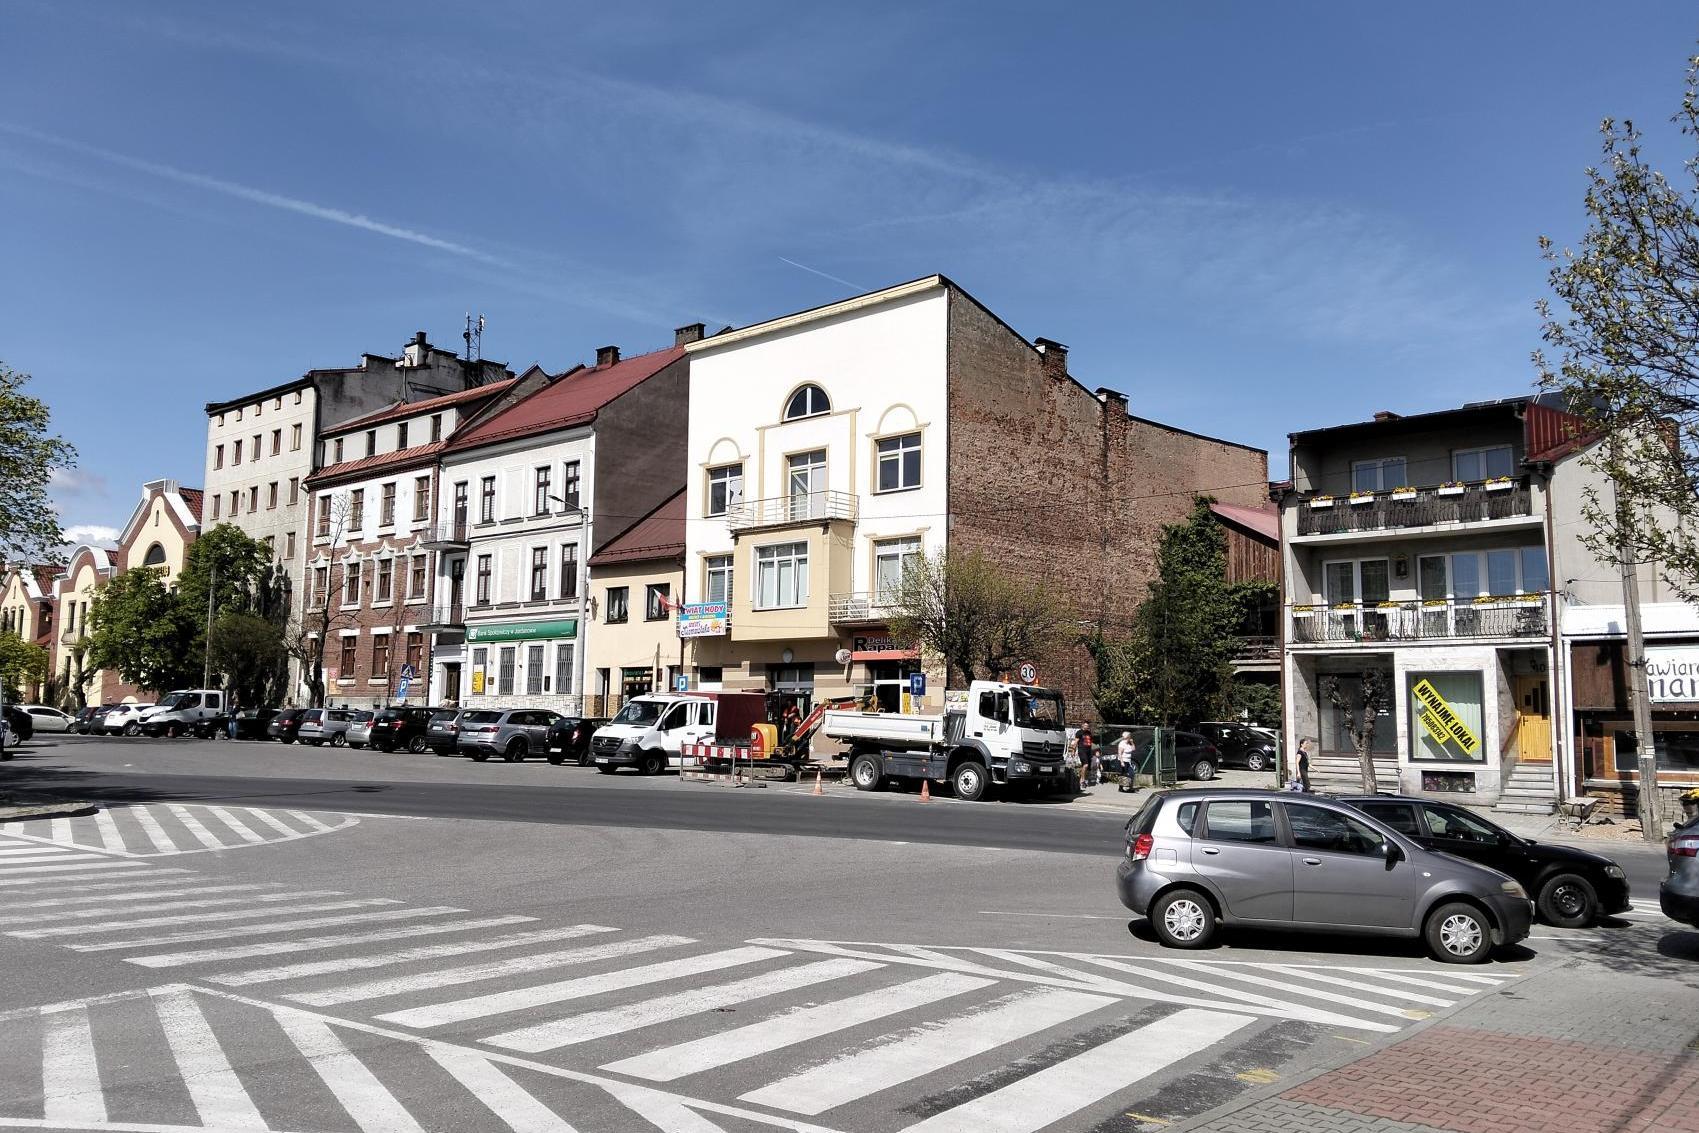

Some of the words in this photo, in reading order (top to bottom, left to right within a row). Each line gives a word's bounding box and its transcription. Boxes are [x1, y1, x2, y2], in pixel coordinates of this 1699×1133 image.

[1022, 667, 1034, 678] 30
[1646, 659, 1699, 676] awiar
[400, 681, 406, 692] P
[679, 678, 686, 692] P
[914, 676, 922, 694] P
[1418, 684, 1455, 727] WYNAJMĘ
[1450, 722, 1476, 750] LOKAL
